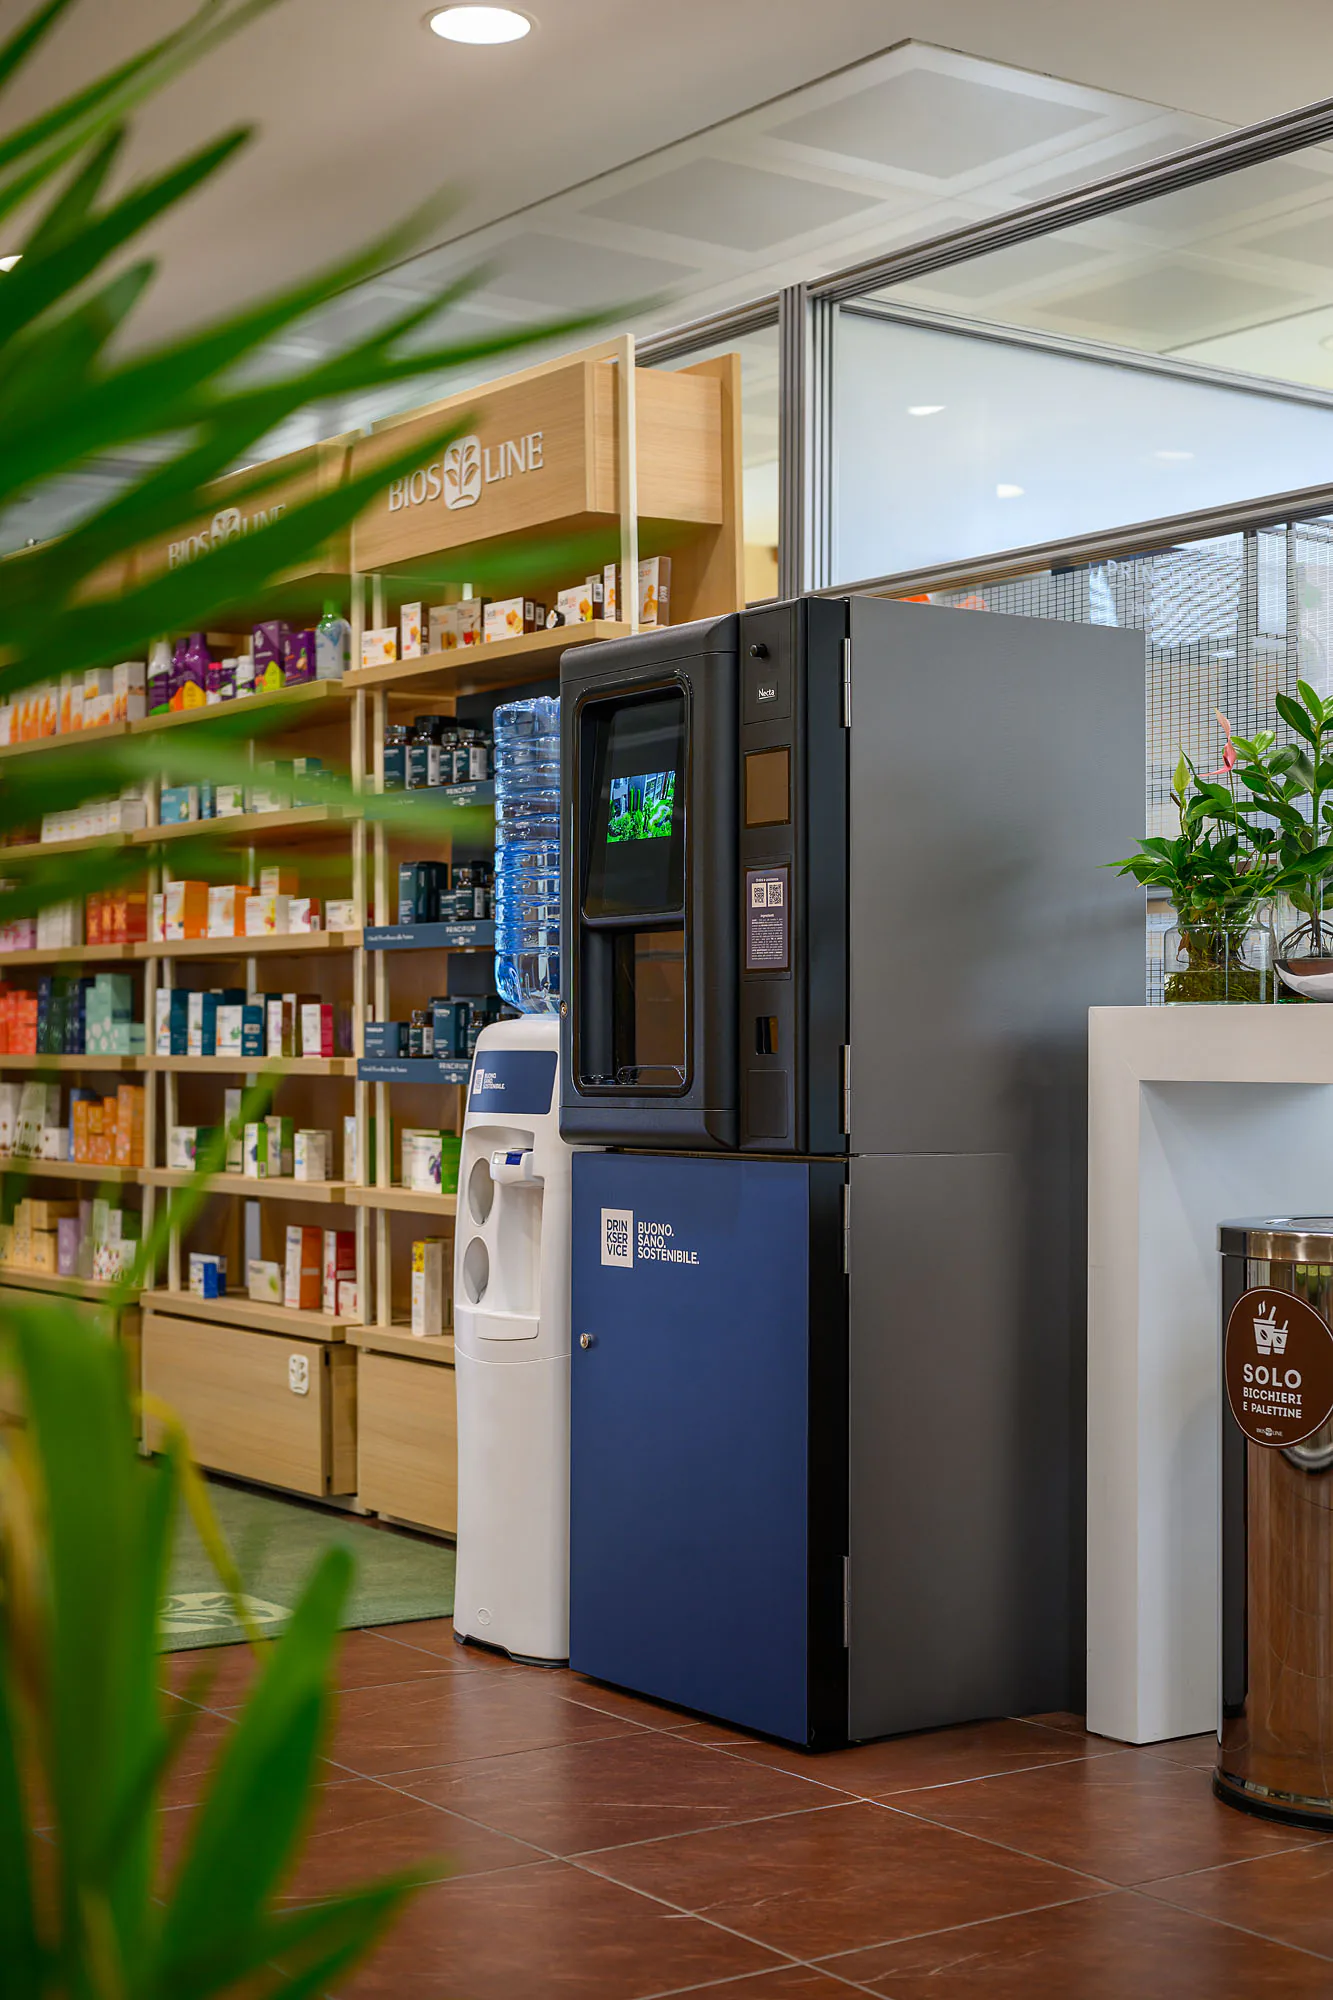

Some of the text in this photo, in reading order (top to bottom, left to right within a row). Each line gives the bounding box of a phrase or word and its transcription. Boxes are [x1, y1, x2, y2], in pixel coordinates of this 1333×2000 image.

[389, 431, 544, 512] BIOS LINE
[759, 688, 774, 698] Necta
[607, 1219, 628, 1232] DRIN
[638, 1222, 674, 1237] BUONO.
[607, 1232, 628, 1244] KSER
[638, 1234, 666, 1248] SANO.
[607, 1244, 628, 1256] VICE
[638, 1247, 699, 1265] SOSTENIBILE.
[1243, 1363, 1302, 1389] SOLO
[1243, 1387, 1302, 1405] BICCHIERI
[1243, 1401, 1302, 1419] E PALETTINE
